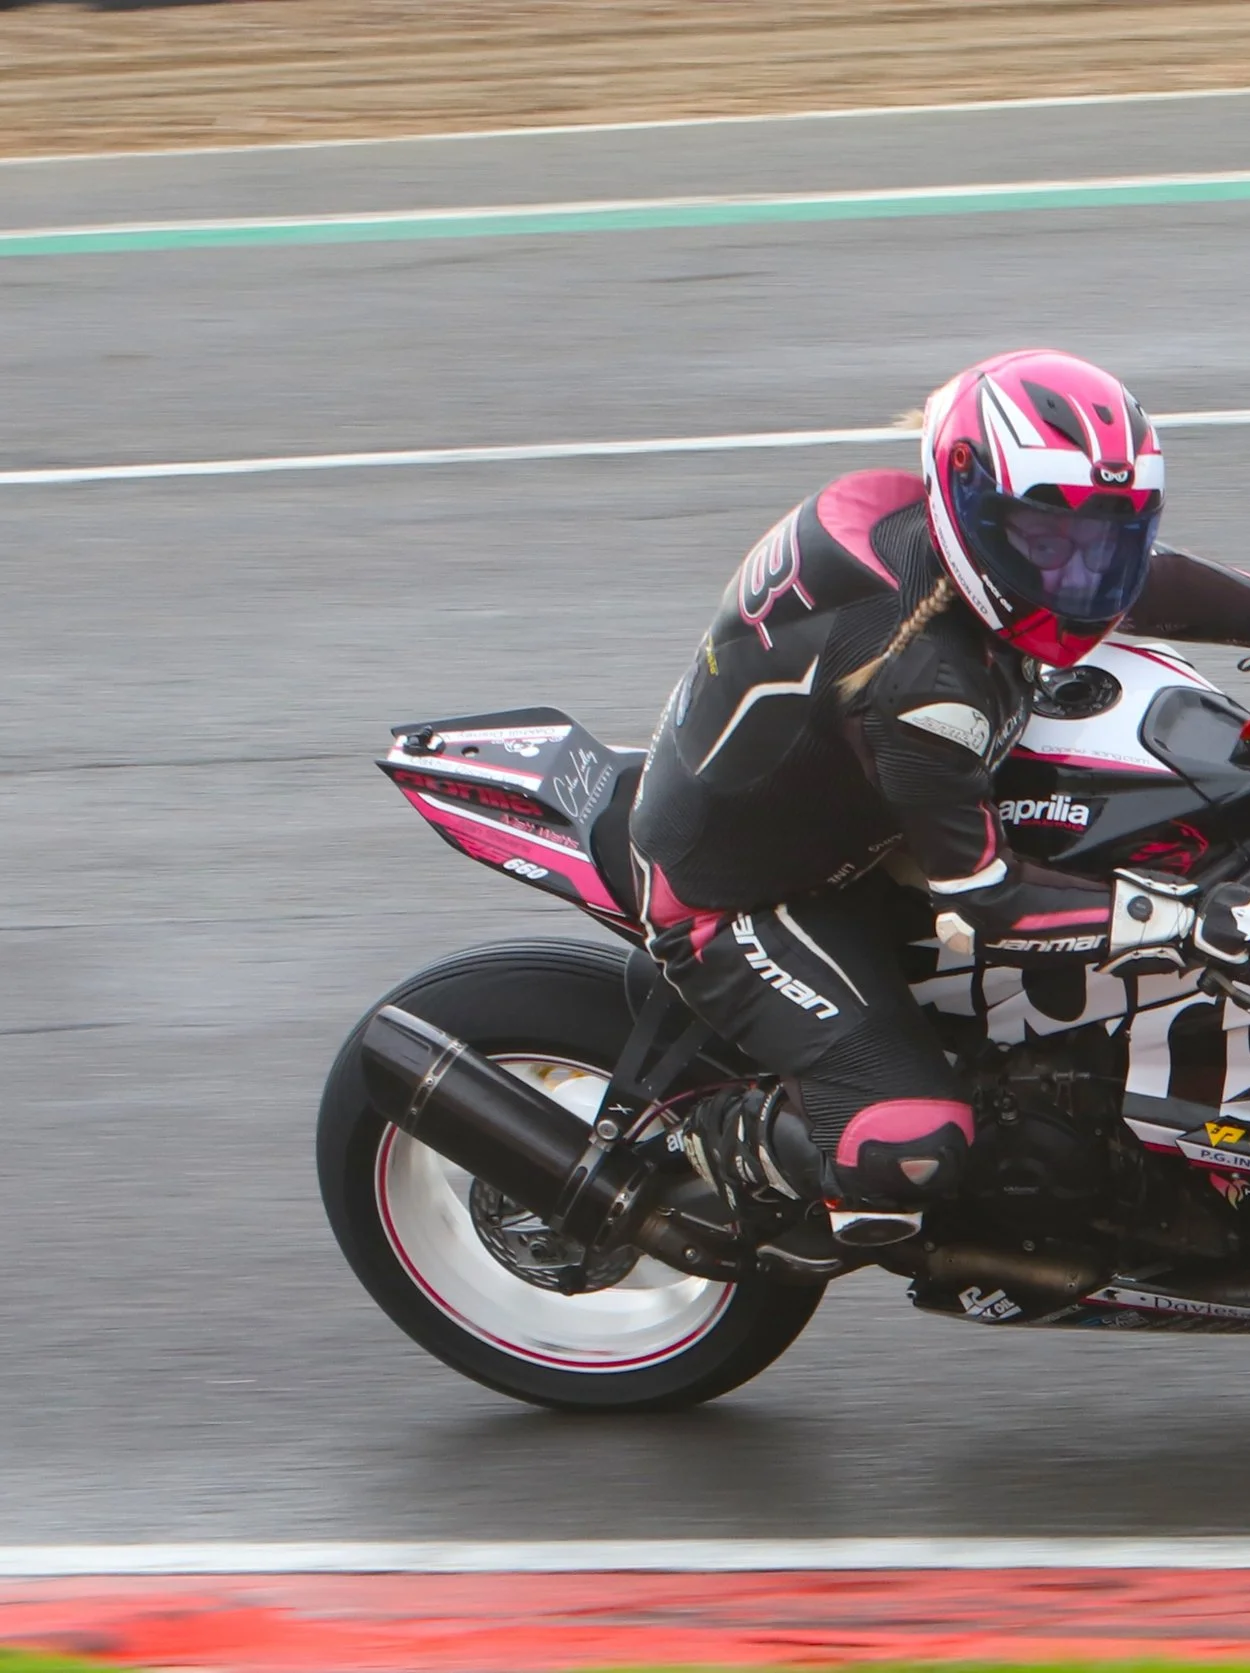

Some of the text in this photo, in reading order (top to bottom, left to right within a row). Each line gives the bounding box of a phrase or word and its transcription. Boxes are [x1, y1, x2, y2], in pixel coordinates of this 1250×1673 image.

[999, 794, 1090, 826] aprilia
[503, 858, 549, 880] 660
[732, 911, 840, 1021] anman
[1153, 1295, 1238, 1318] Davies
